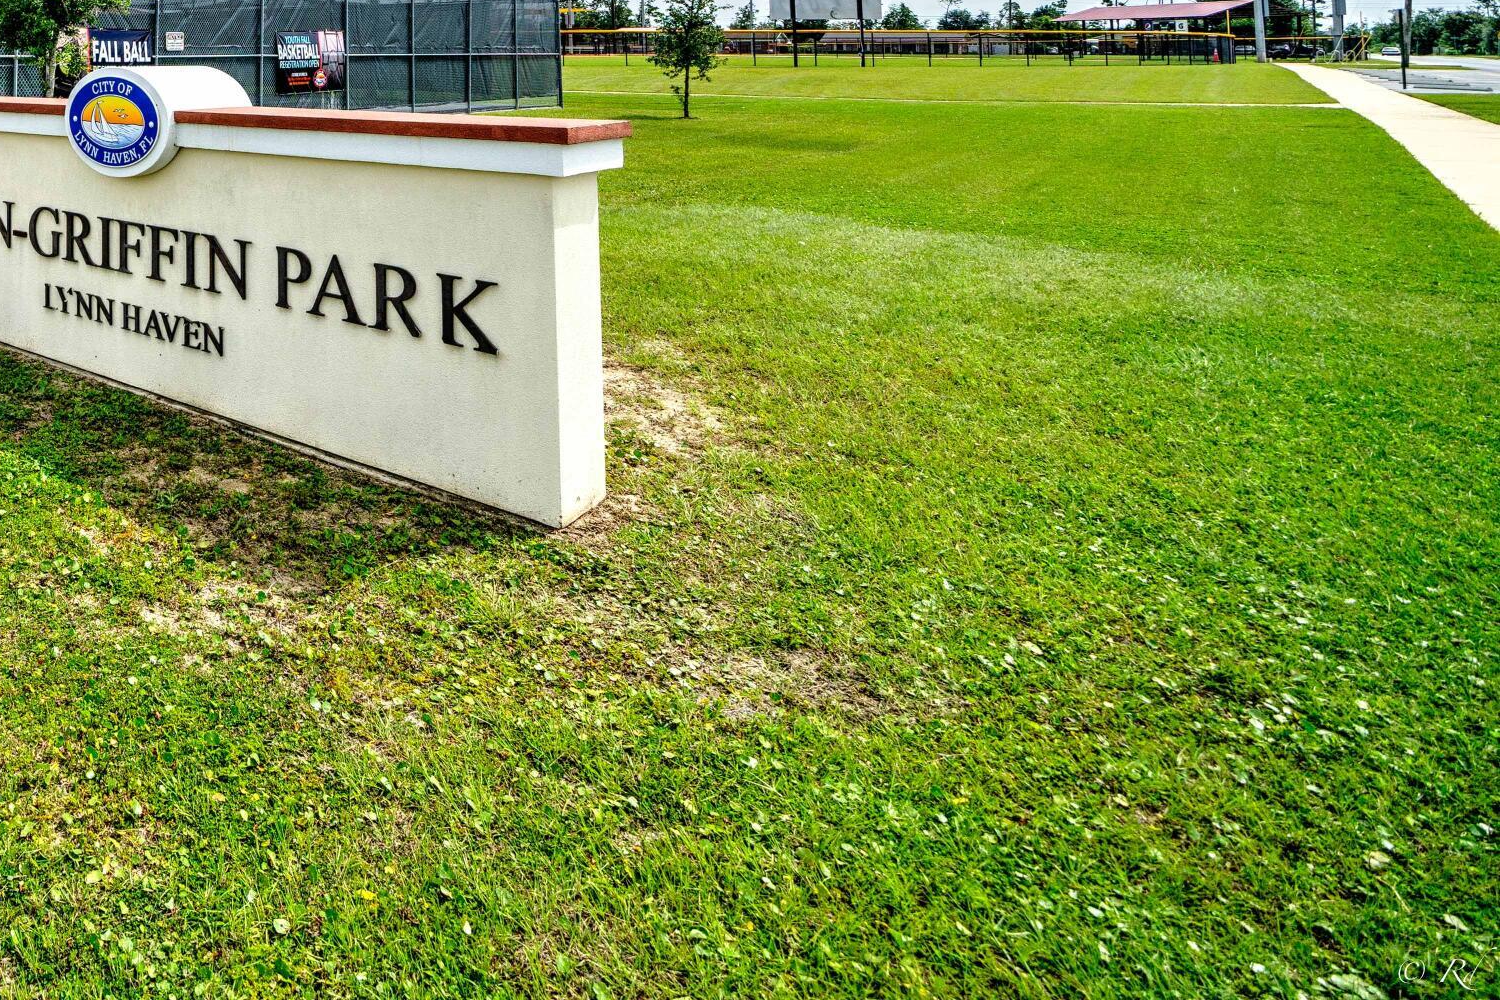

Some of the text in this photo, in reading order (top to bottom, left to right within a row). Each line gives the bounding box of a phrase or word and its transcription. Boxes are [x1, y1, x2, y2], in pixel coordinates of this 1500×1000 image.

[92, 40, 151, 63] FALL BALL
[278, 44, 320, 60] BASKETBALL
[91, 80, 133, 96] CITY OF
[74, 130, 99, 158] LYNN
[139, 135, 154, 153] FL
[275, 245, 500, 356] PARK
[43, 283, 225, 357] LYNN HAVEN
